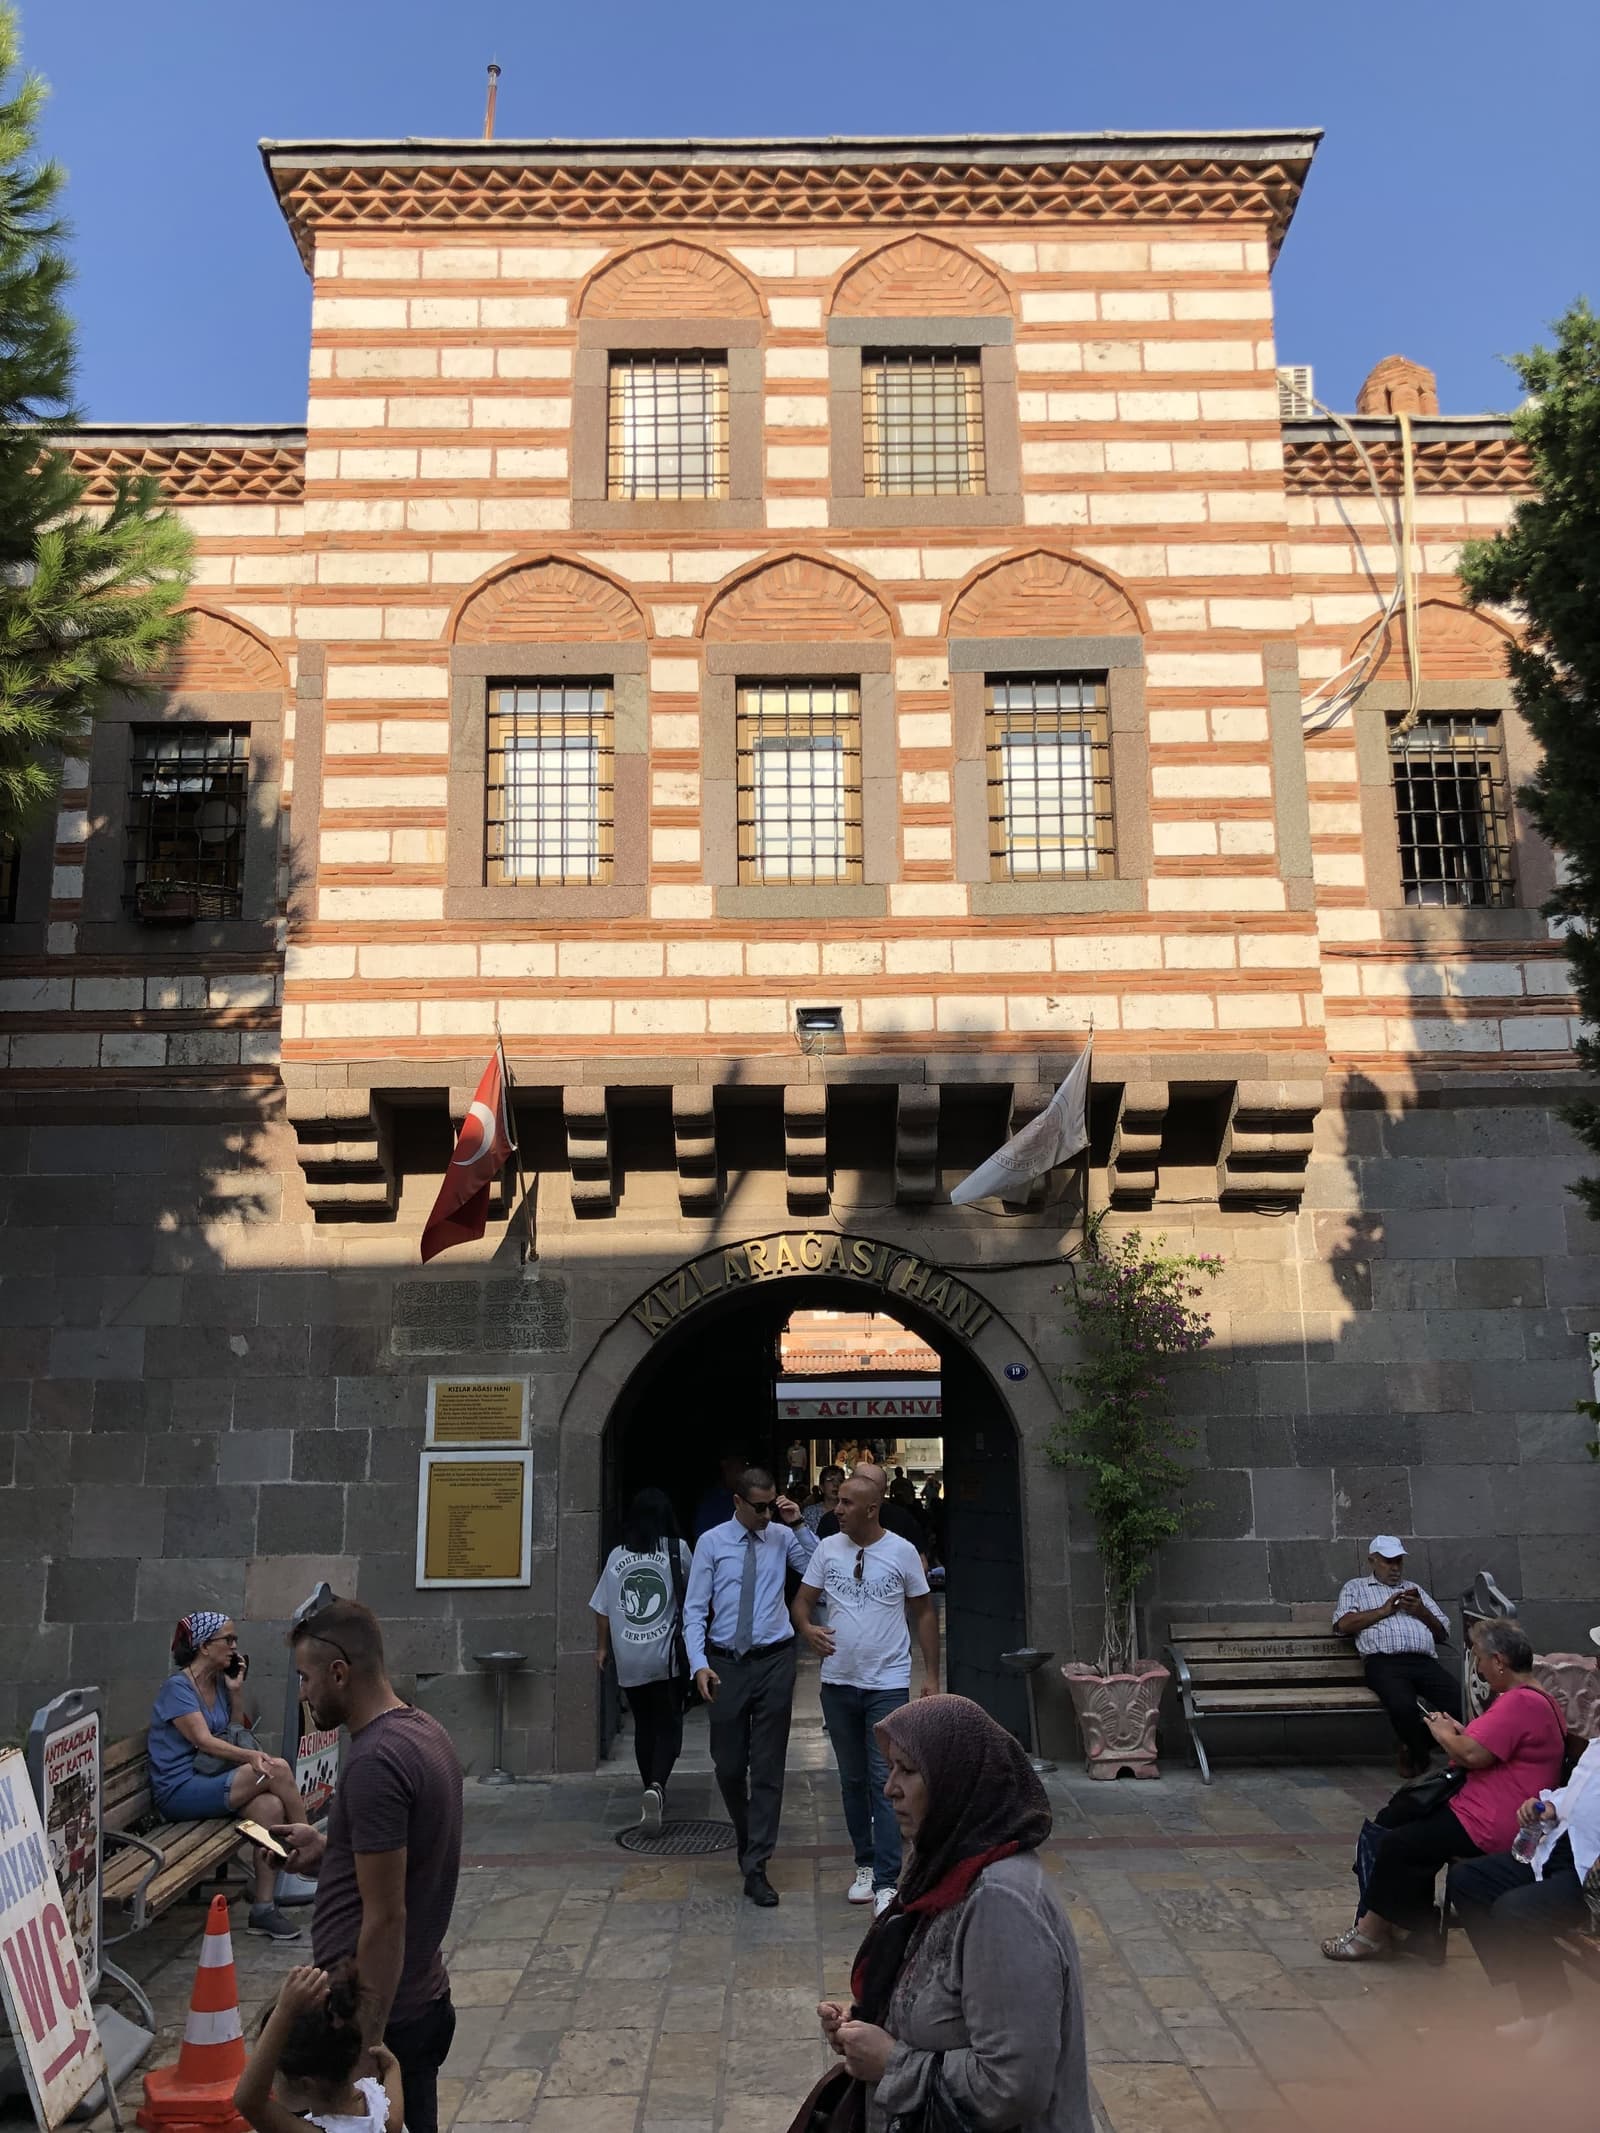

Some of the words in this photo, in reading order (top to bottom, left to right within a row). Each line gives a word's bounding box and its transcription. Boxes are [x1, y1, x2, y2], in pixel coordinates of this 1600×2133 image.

[899, 1256, 993, 1338] HANI
[818, 1400, 858, 1416] ACI
[615, 1553, 643, 1574] SOUTH
[647, 1553, 666, 1566] SIDE
[625, 1623, 668, 1641] SERPENTS
[48, 1763, 65, 1784] ÜST
[66, 1748, 95, 1775] KATTA
[0, 1775, 19, 1832] AY
[0, 1832, 48, 1915] AYAN
[3, 1903, 80, 2043] WC
